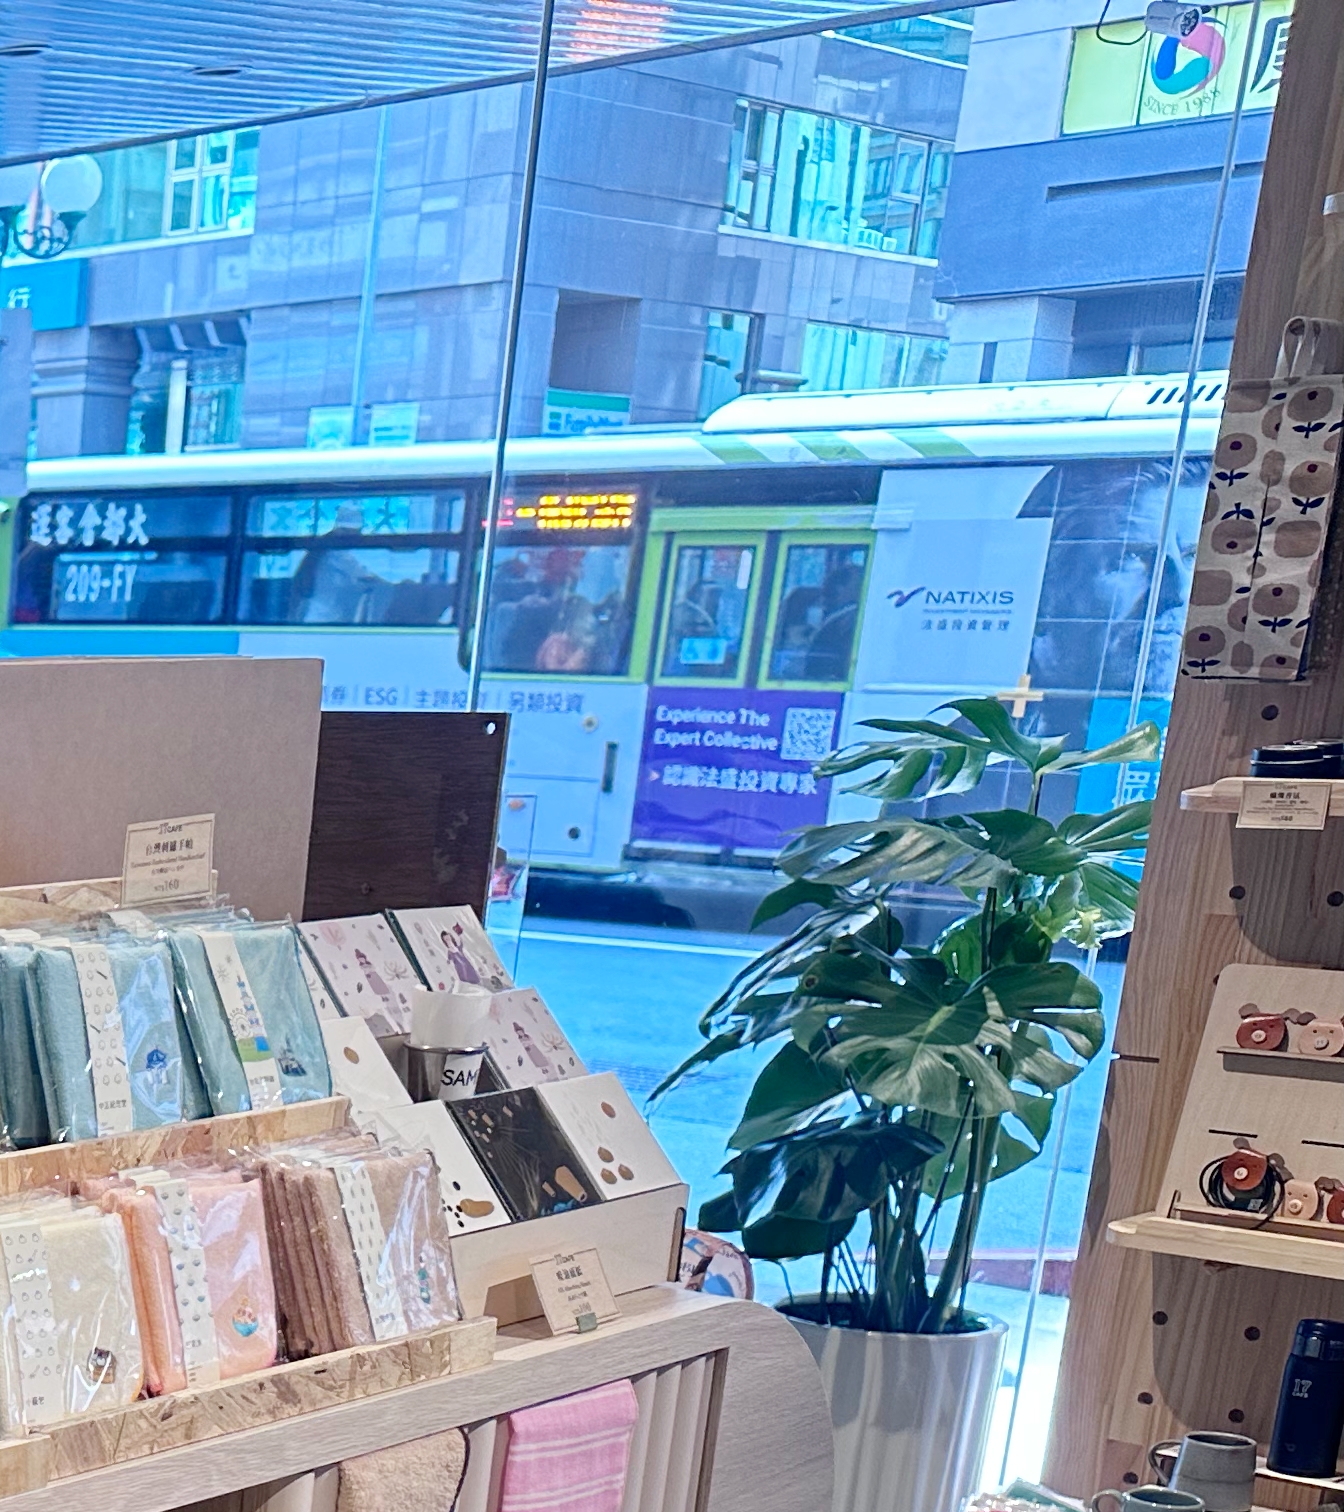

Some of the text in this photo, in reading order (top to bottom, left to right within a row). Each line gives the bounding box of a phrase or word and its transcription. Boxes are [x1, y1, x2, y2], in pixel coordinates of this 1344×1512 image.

[1143, 95, 1179, 115] SINCE
[924, 590, 1015, 605] NATIXIS
[364, 687, 398, 707] ESG
[655, 704, 771, 727] Experience The
[653, 727, 779, 751] Expert Collective
